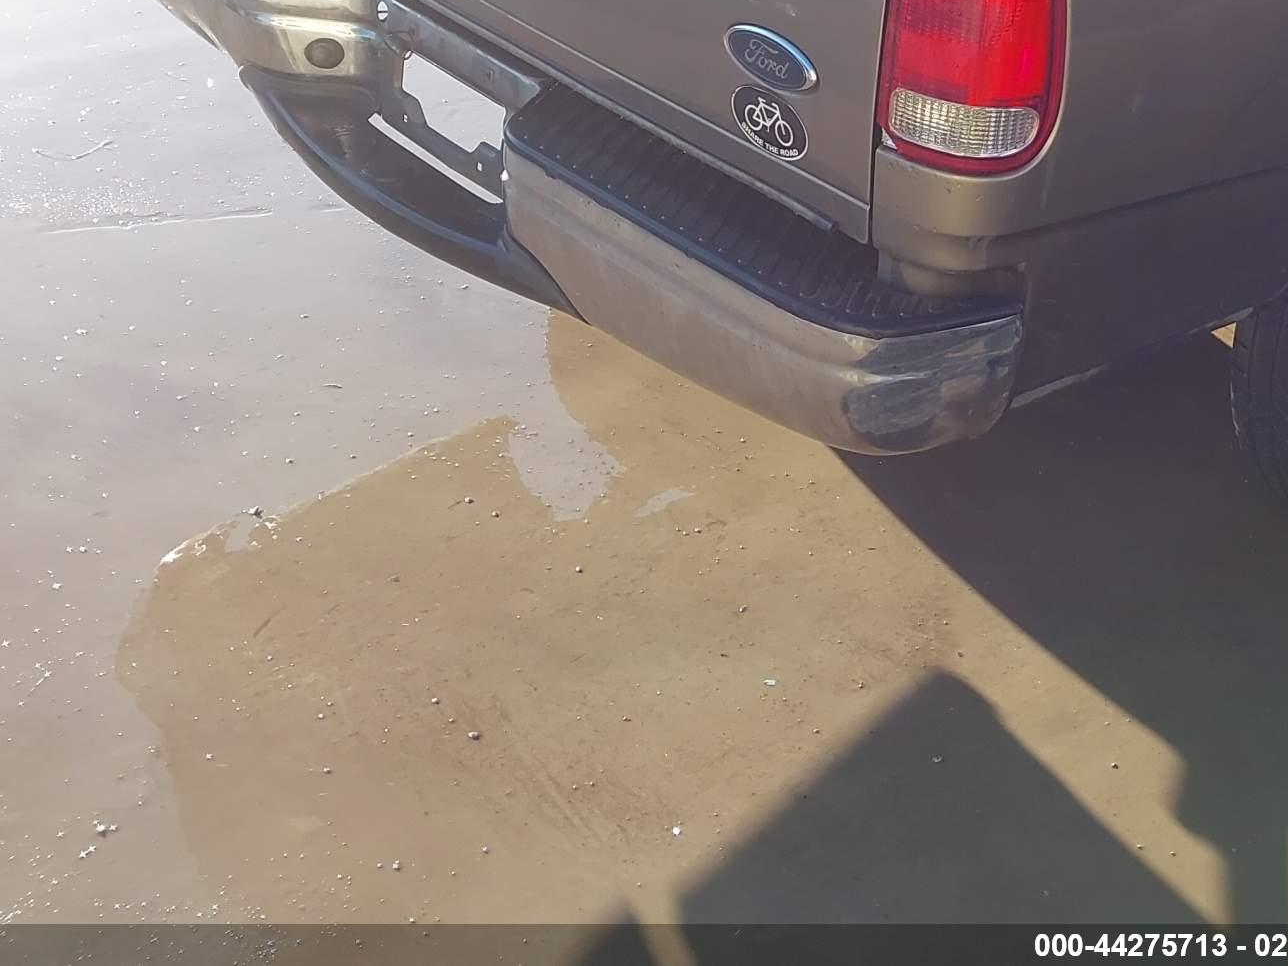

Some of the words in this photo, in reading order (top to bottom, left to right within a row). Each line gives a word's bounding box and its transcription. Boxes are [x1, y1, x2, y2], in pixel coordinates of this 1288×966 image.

[744, 39, 790, 79] Ford
[741, 122, 764, 147] SHARE
[765, 142, 779, 155] THE
[780, 148, 799, 157] ROAD
